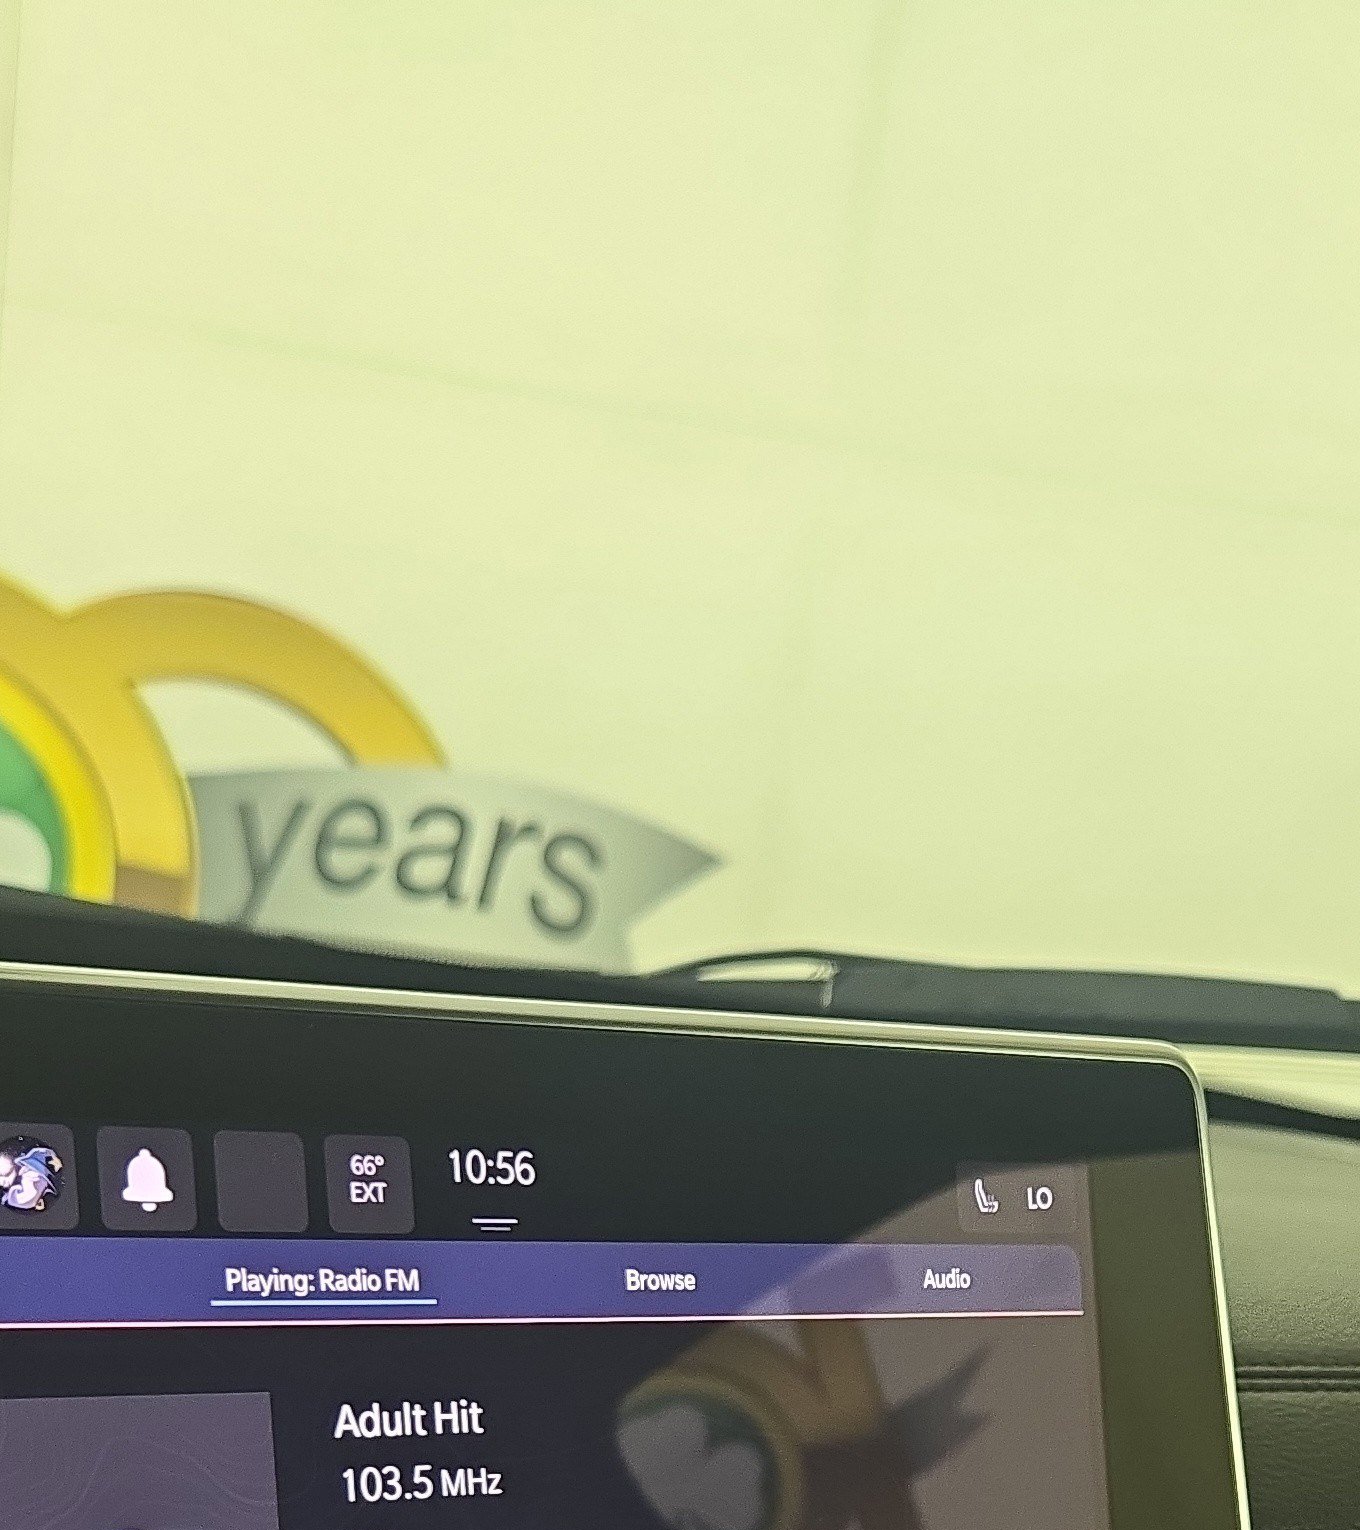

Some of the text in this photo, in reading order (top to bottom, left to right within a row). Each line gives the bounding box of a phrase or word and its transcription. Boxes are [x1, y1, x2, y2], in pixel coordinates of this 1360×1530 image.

[236, 795, 605, 934] years
[448, 1148, 536, 1186] 10:56
[349, 1181, 388, 1203] EXT
[1026, 1186, 1053, 1210] LO
[225, 1267, 420, 1298] Playing: Radio FM
[625, 1268, 696, 1291] Browse
[923, 1267, 971, 1289] Audio
[334, 1398, 485, 1439] Adult Hit
[342, 1464, 503, 1503] 103.5 MHz
